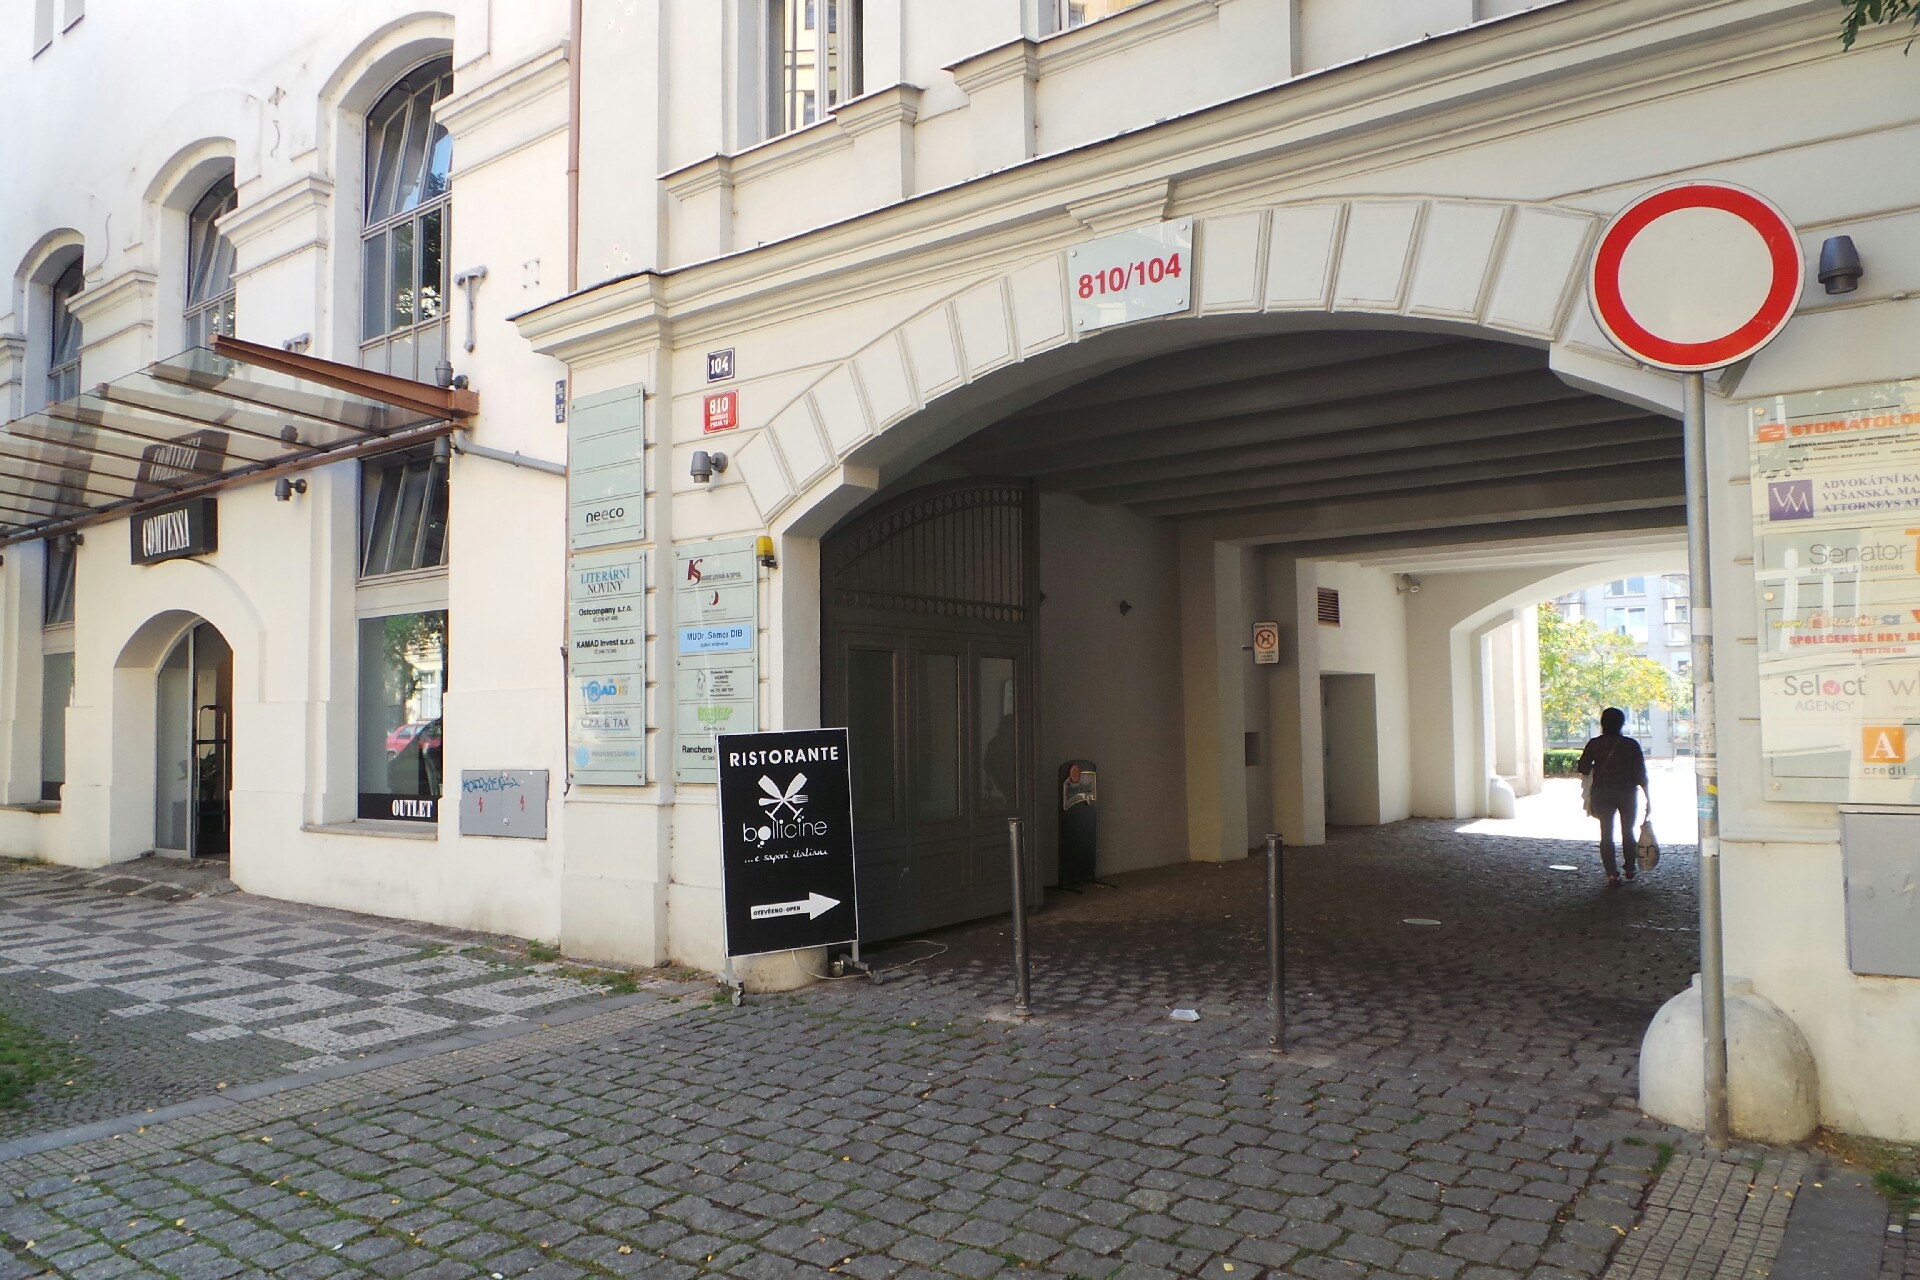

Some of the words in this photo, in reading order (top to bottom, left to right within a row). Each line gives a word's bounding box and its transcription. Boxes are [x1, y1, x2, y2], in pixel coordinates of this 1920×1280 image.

[1078, 252, 1182, 299] 810/104
[710, 355, 729, 375] 104
[709, 396, 729, 415] 810
[1822, 473, 1899, 490] ADVOKÁTNÍ
[1823, 499, 1901, 513] ATTORNEYS
[586, 507, 624, 523] neeco
[142, 508, 190, 557] COMTESSA
[1809, 541, 1907, 565] Senator
[581, 565, 630, 584] LITERÁRNÍ
[1861, 563, 1905, 572] Incentives
[588, 580, 622, 594] NOVINY
[578, 606, 615, 616] Ostcompany
[730, 629, 743, 638] DIB
[1789, 633, 1873, 645] SPOLEČENSKÉ
[577, 640, 599, 648] KAMAD
[1795, 699, 1855, 712] AGENCY
[612, 717, 629, 728] TAX
[682, 745, 712, 754] Ranchero
[1869, 731, 1899, 759] A
[730, 746, 839, 767] RISTORANTE
[1863, 766, 1907, 776] credit
[391, 799, 433, 818] OUTLET
[743, 818, 828, 843] bollicine
[763, 850, 789, 864] sapori
[792, 848, 828, 859] italiani
